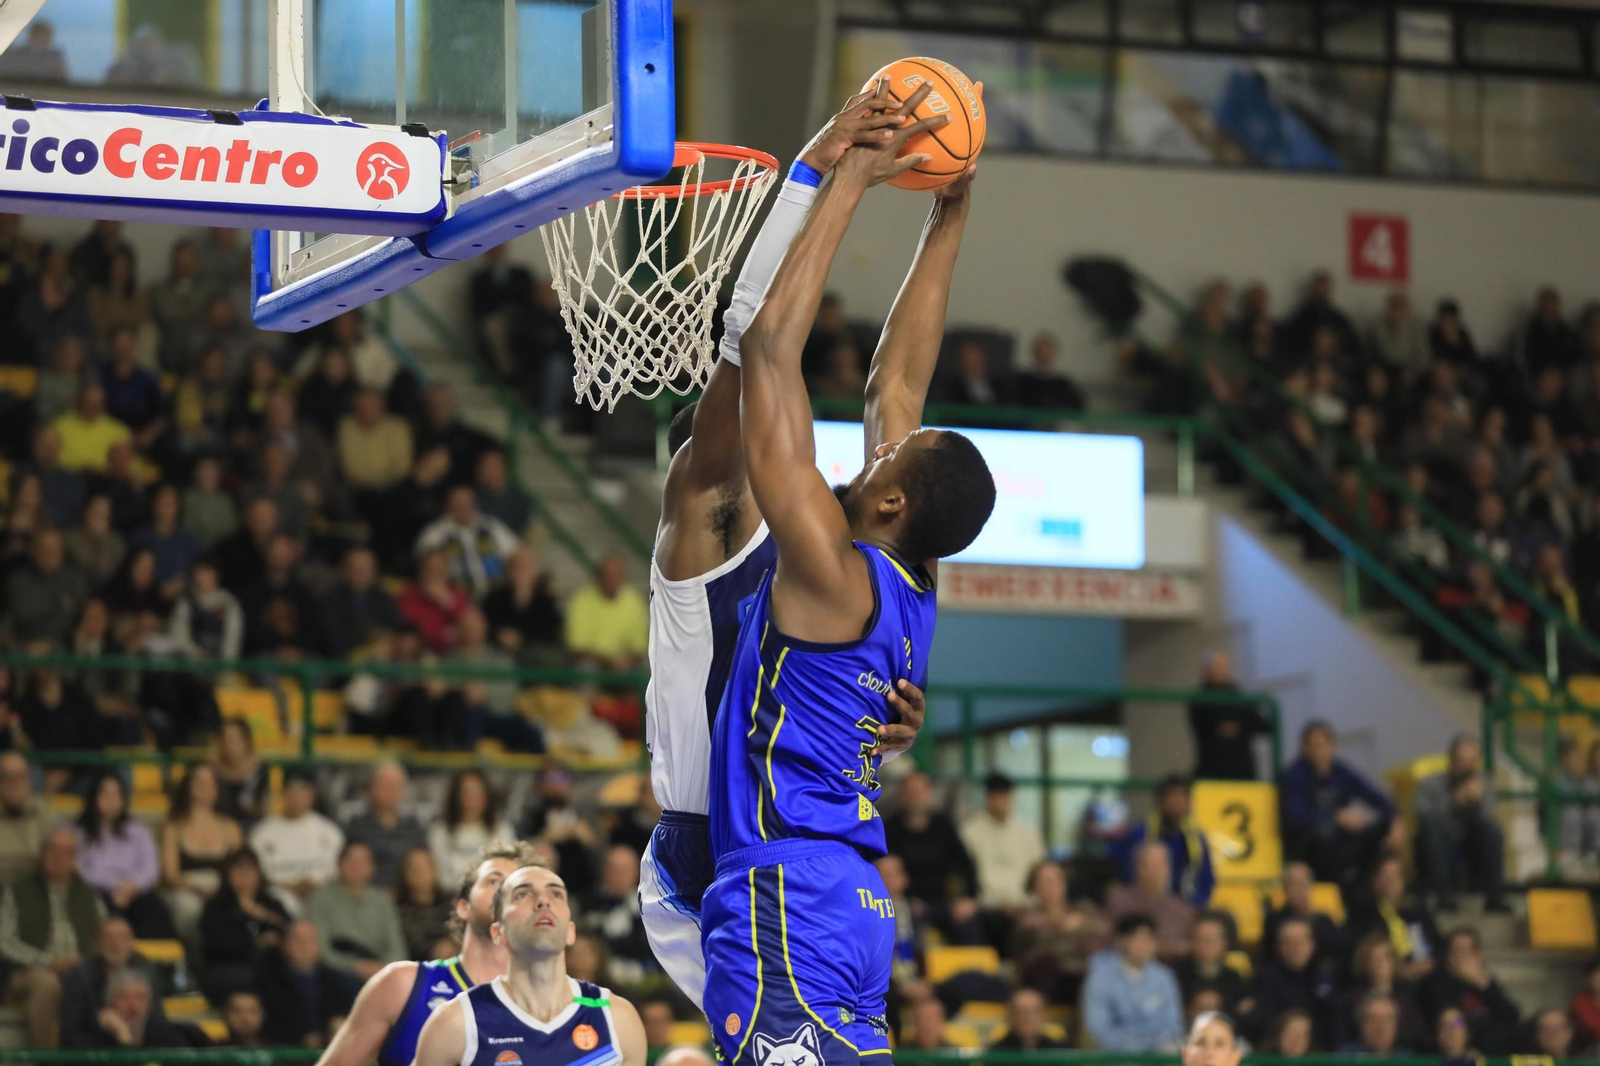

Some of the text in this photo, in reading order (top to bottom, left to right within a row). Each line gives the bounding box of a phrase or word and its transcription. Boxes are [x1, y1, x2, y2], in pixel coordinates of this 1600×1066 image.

[0, 118, 319, 188] icoCentro
[1361, 224, 1396, 270] 4
[1219, 801, 1256, 862] 3
